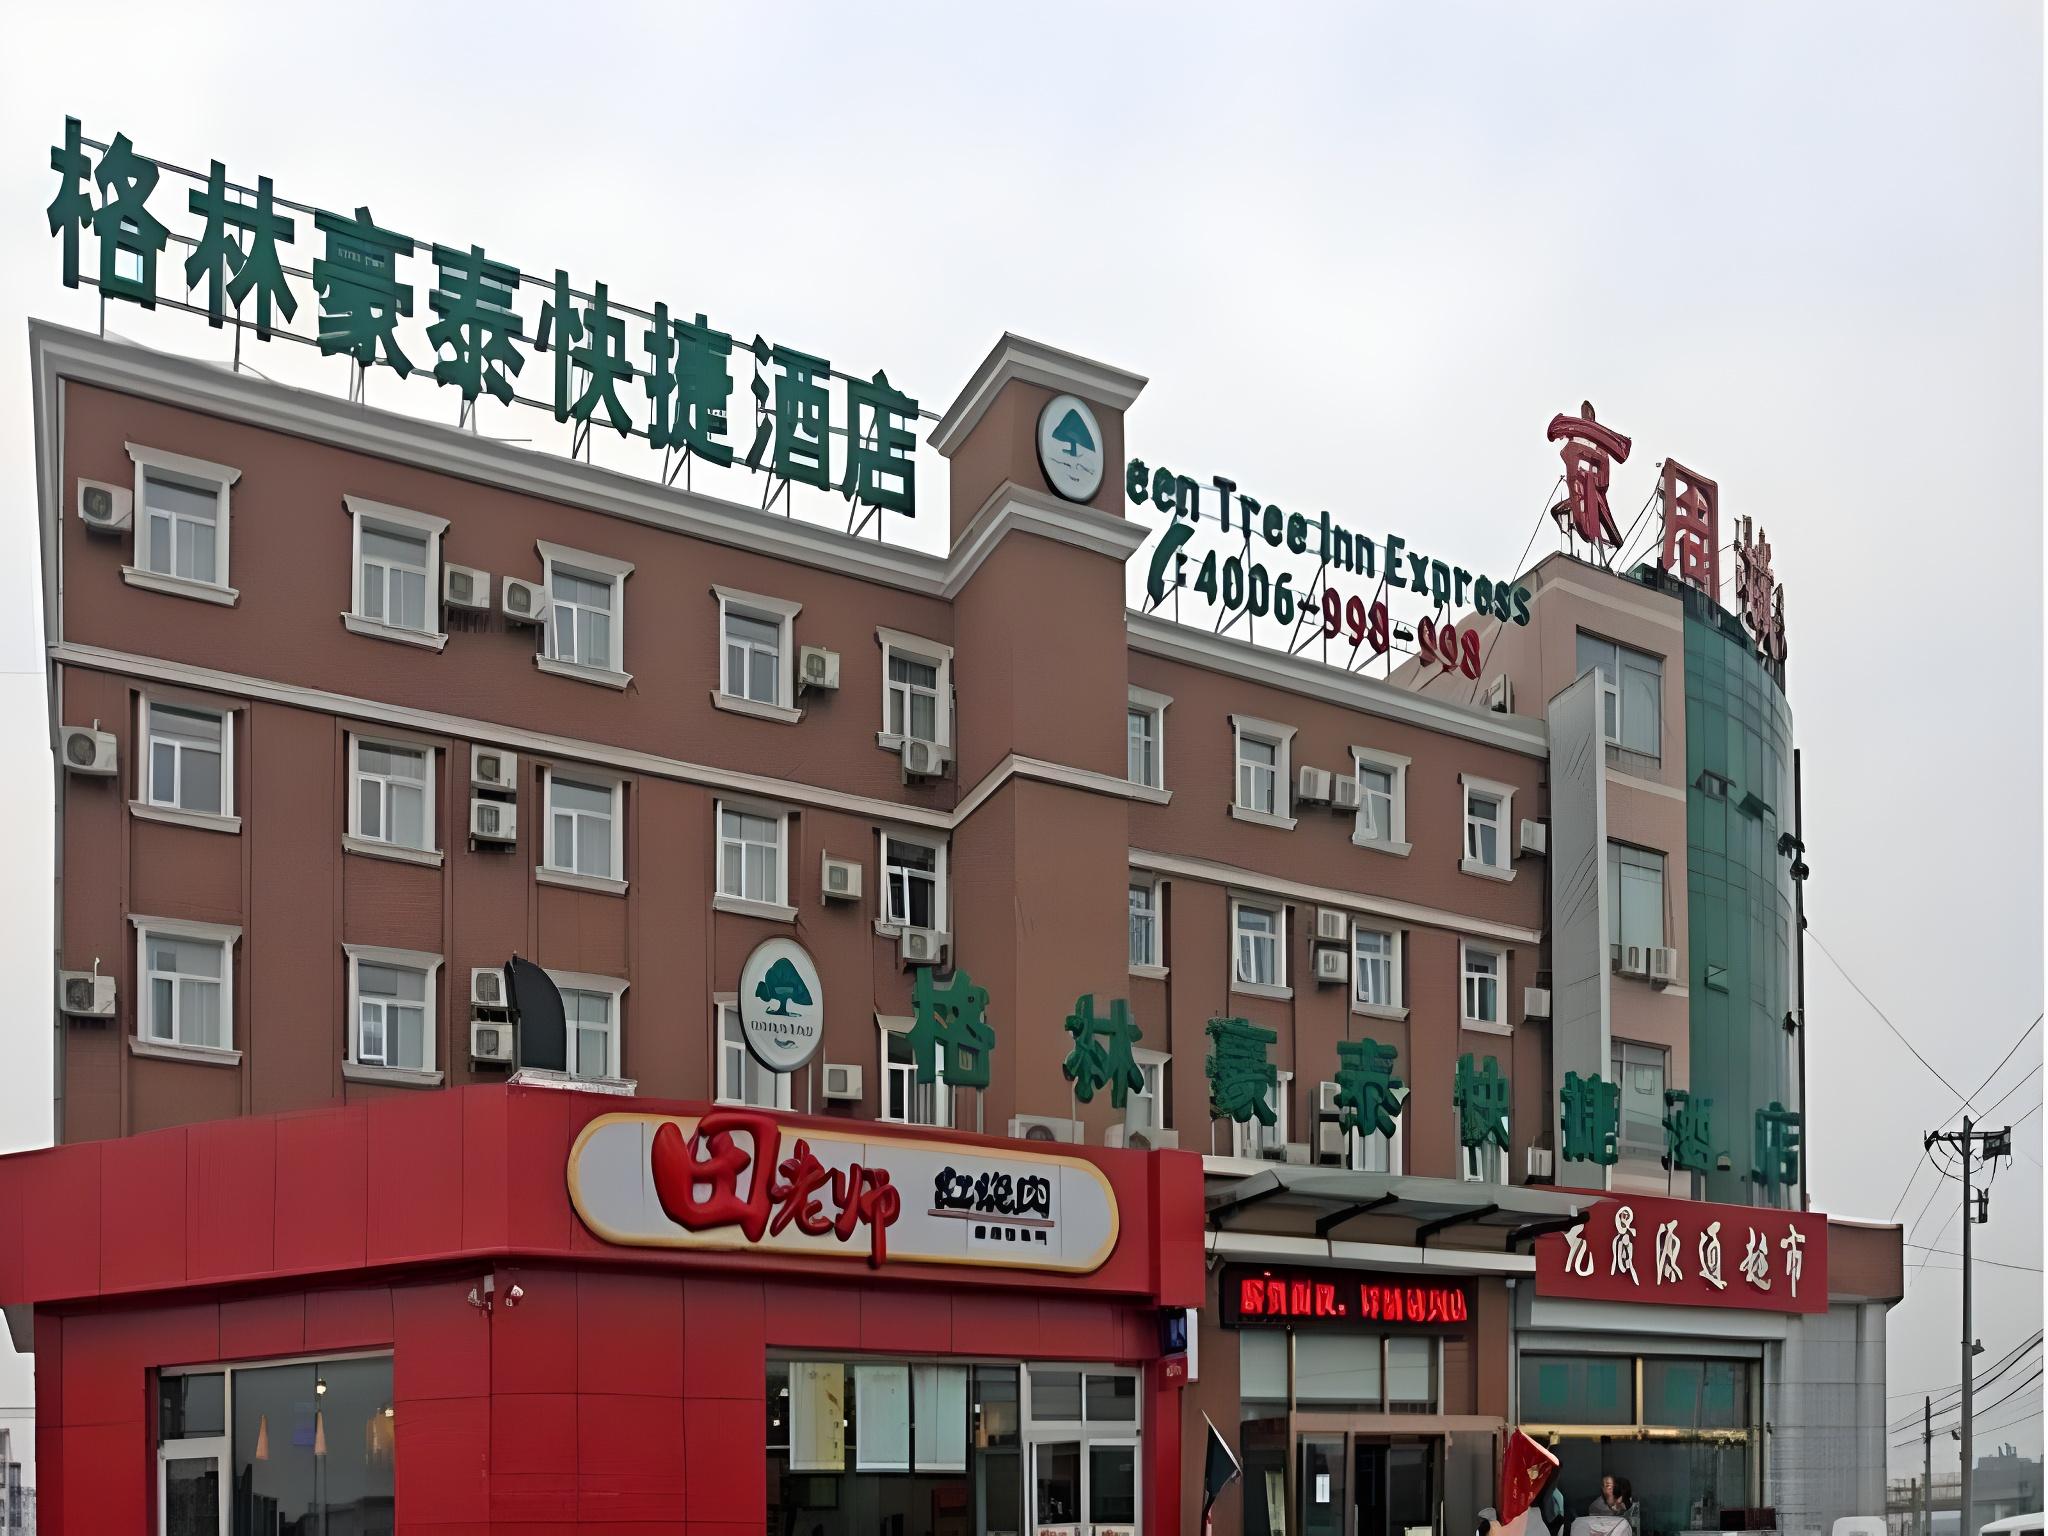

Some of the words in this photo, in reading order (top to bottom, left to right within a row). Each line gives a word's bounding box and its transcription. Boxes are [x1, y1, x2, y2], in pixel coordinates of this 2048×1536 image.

[47, 115, 919, 517] 格林豪泰快捷酒店
[1213, 475, 1307, 554] Tree
[1320, 511, 1375, 578] Inn
[1386, 533, 1531, 626] Express
[651, 1112, 901, 1270] 田老师
